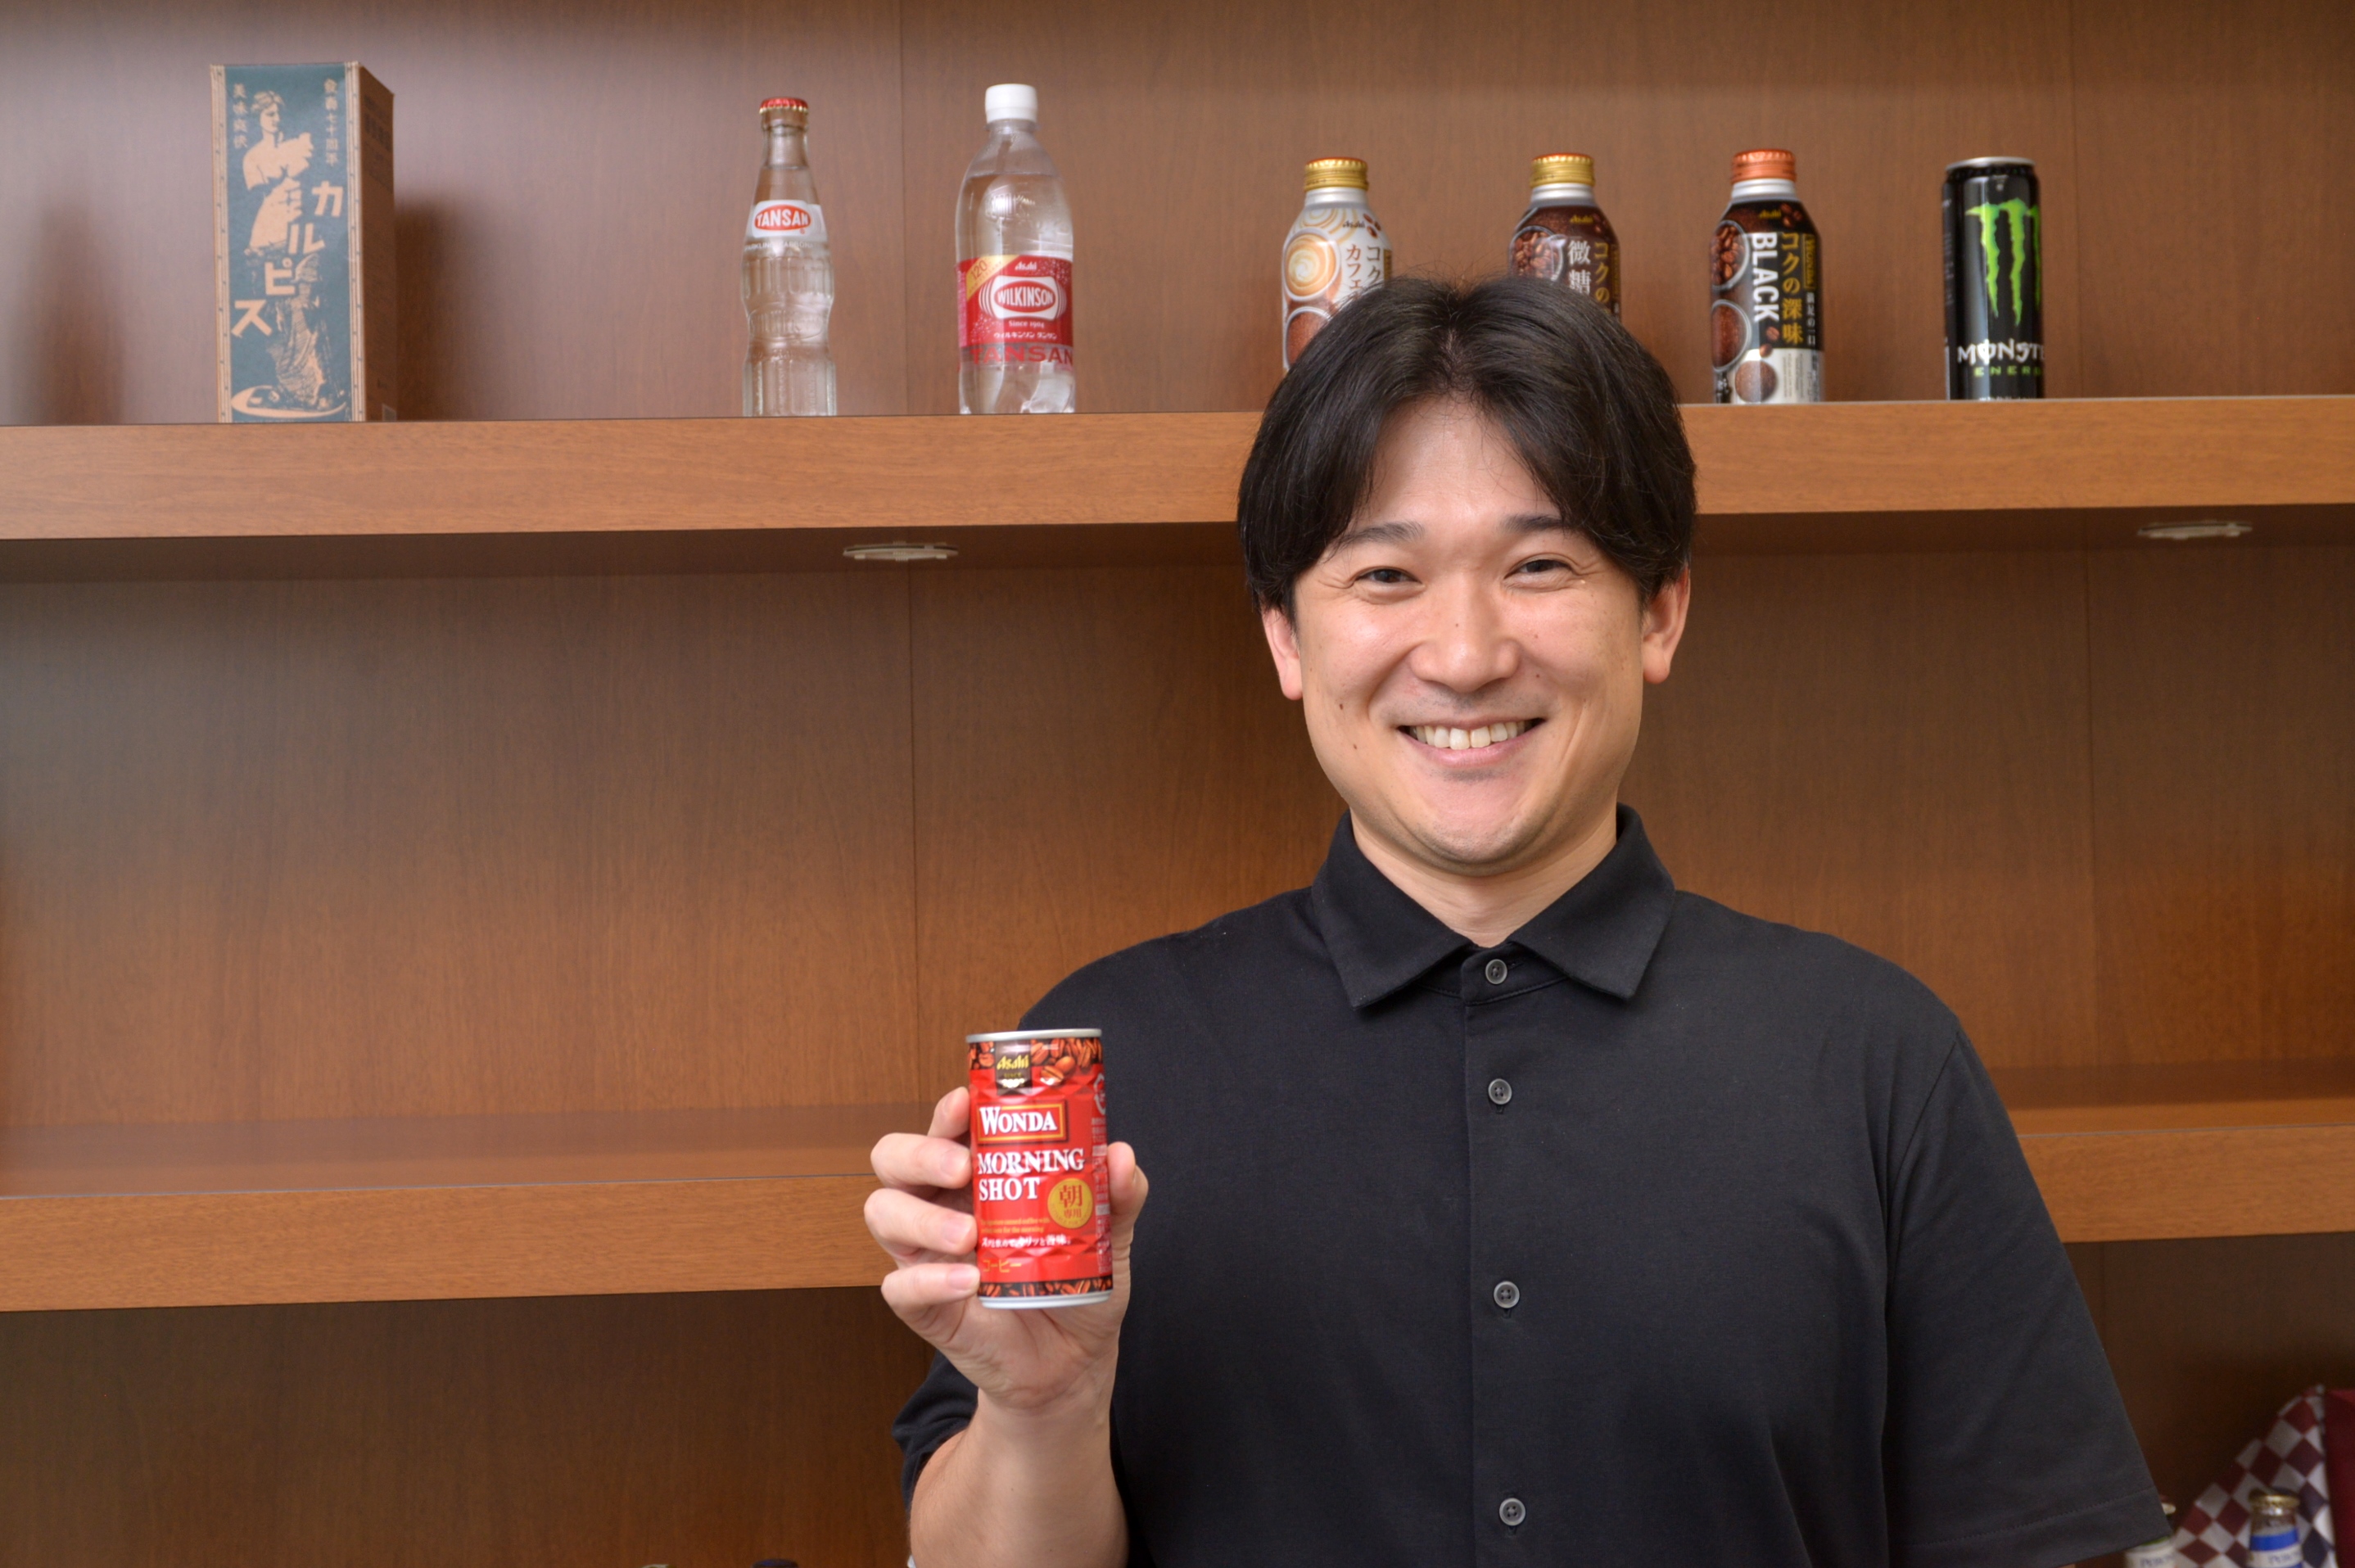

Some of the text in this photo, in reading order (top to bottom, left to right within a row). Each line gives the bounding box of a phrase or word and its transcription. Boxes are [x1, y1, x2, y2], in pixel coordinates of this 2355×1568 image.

[756, 208, 809, 228] TANSAN
[1342, 219, 1366, 228] Asahi
[1569, 215, 1594, 224] Asahi
[1760, 209, 1782, 219] Asahi
[231, 180, 344, 337] カルピス
[1015, 261, 1037, 271] Asahi
[1567, 240, 1592, 295] 微糖
[970, 259, 988, 280] 120
[1593, 242, 1611, 314] コクの
[1751, 233, 1780, 323] BLACK
[997, 286, 1053, 307] WILKINSON
[1782, 233, 1804, 346] コクの深味
[993, 331, 1035, 339] ウィルキンソン
[969, 345, 1074, 366] TANSAN
[997, 1055, 1029, 1070] Asahi
[979, 1106, 1058, 1136] WONDA
[977, 1148, 1085, 1175] MORNING
[979, 1177, 1040, 1201] SHOT
[1059, 1184, 1083, 1208] 朝
[983, 1259, 1022, 1273] コーヒー
